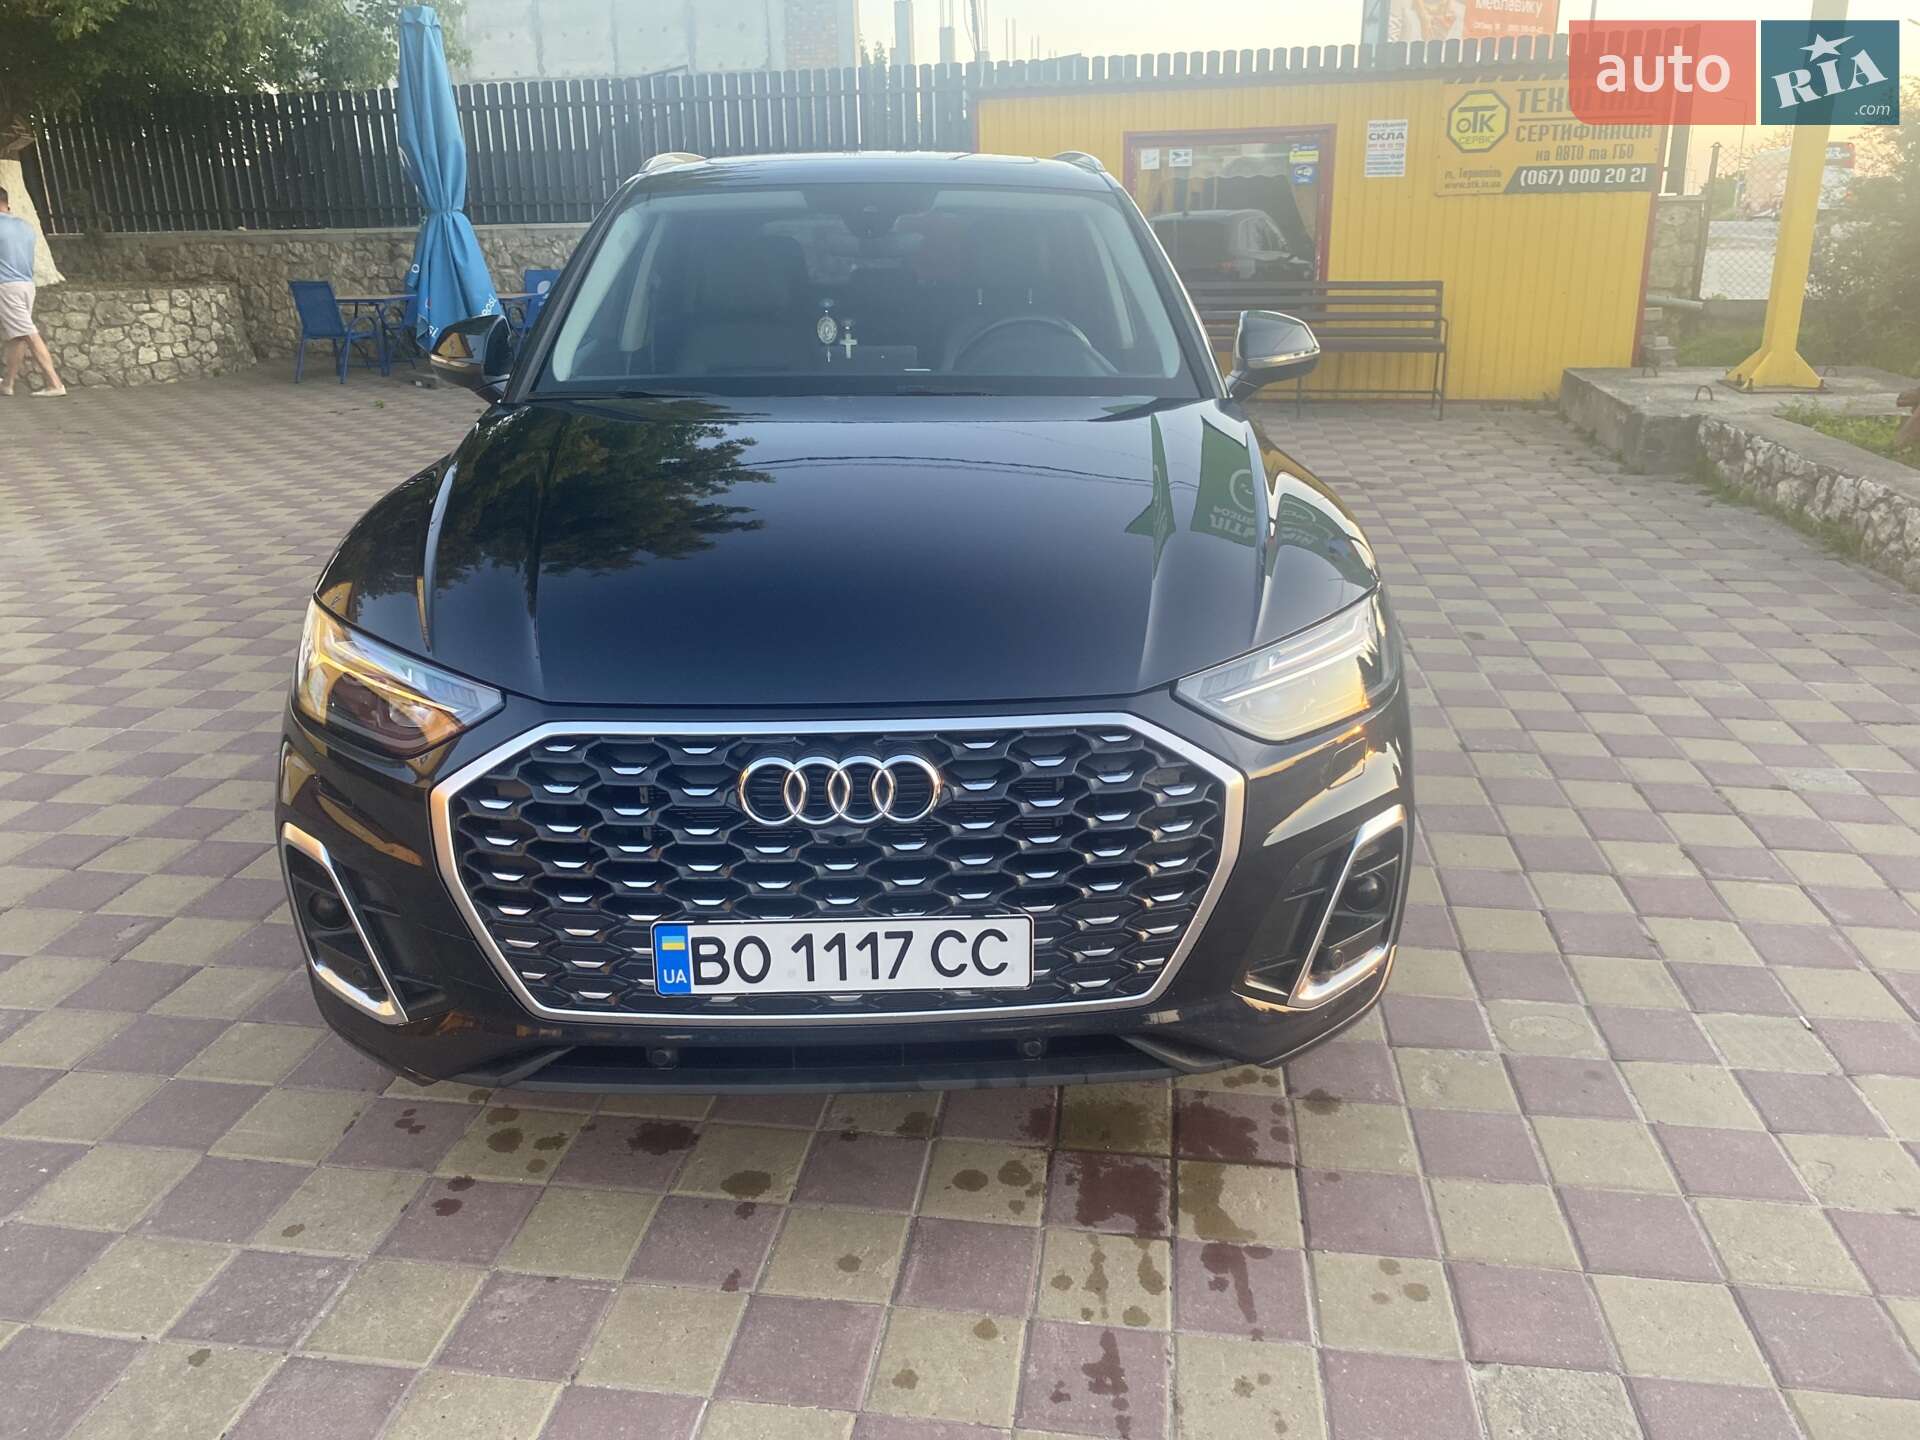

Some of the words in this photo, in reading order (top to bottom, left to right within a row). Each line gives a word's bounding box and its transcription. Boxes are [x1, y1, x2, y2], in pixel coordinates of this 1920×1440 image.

[1368, 132, 1404, 141] СКЛА
[1536, 149, 1550, 161] на
[1555, 145, 1584, 161] АВТО
[1612, 143, 1634, 159] ГБО
[1520, 169, 1564, 186] (067)
[1569, 168, 1600, 184] 000
[1605, 168, 1626, 183] 20
[1630, 167, 1647, 182] 21
[691, 935, 771, 986] BO
[791, 930, 913, 982] 1117
[930, 928, 1008, 978] CC
[664, 969, 687, 985] UA
